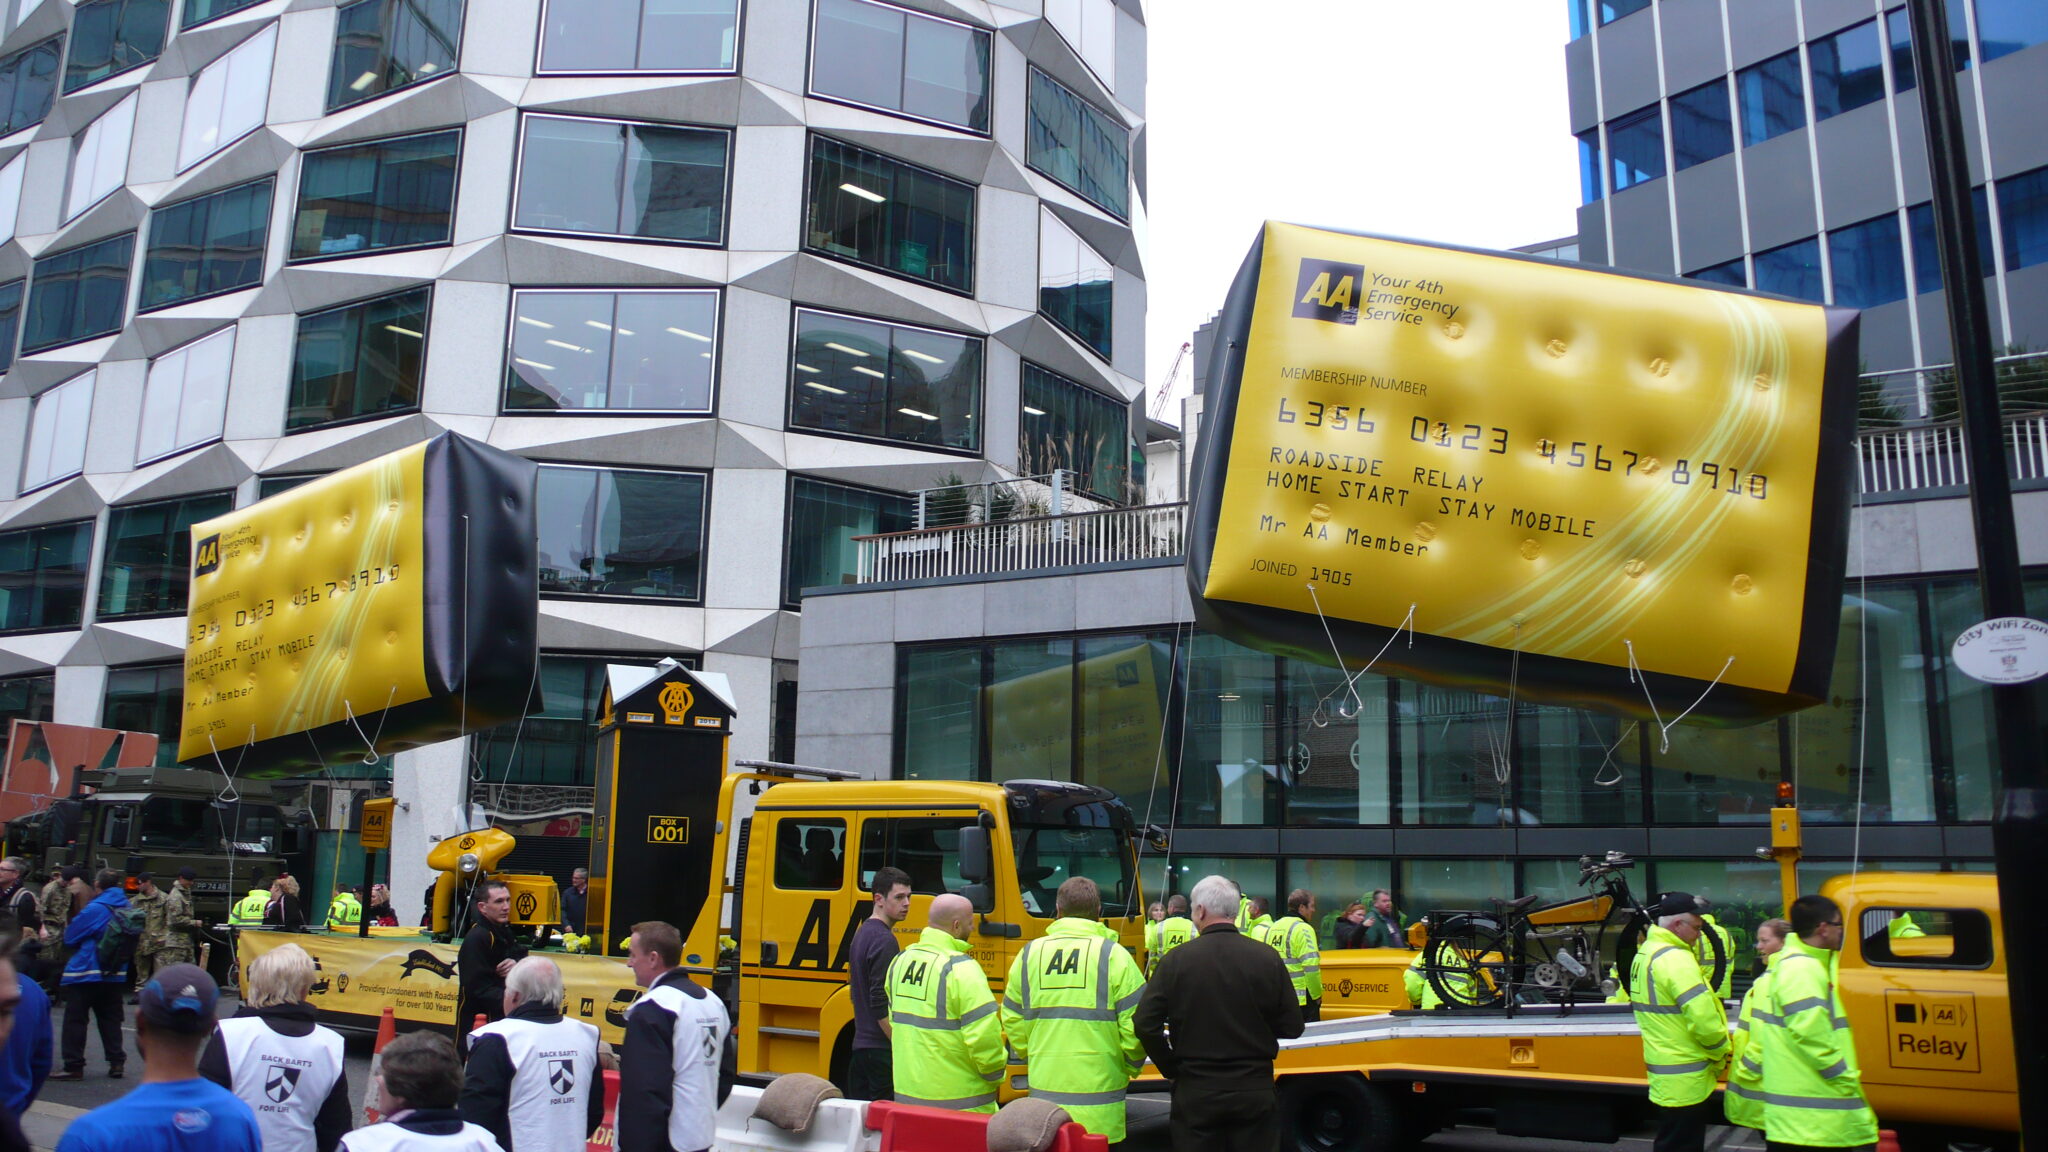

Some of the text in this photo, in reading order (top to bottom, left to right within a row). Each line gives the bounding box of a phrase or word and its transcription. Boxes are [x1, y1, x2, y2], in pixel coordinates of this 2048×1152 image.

[1300, 271, 1354, 309] AA
[1372, 272, 1444, 296] Your 4th
[1363, 307, 1423, 325] Service
[1366, 290, 1460, 319] Emergency
[1281, 367, 1428, 397] MEMBERSHIP NUMBER
[1278, 398, 1767, 500] 6356 0123 4567 8910
[1270, 447, 1483, 493] ROADSIDE RELAY
[1267, 471, 1596, 538] HOME START STAY MOBILE
[1260, 514, 1429, 557] Mr AA Member
[197, 541, 217, 569] AA
[1250, 558, 1352, 586] JOINED 1905
[236, 634, 264, 653] RELAY
[1957, 627, 1983, 647] City
[2021, 620, 2048, 637] Zon
[210, 658, 238, 676] START
[250, 647, 272, 665] STAY
[278, 634, 316, 657] MOBILE
[216, 686, 254, 702] Member
[366, 815, 383, 827] AA
[660, 818, 677, 827] BOX
[653, 826, 684, 842] 001
[248, 904, 260, 913] AA
[1169, 934, 1184, 946] AA
[901, 960, 927, 987] AA
[1045, 948, 1080, 976] AA
[359, 983, 386, 995] Providing
[386, 986, 418, 997] Londoners
[1354, 983, 1390, 993] SERVICE
[396, 998, 453, 1013] for over 100 Years
[1936, 1006, 1954, 1021] AA
[261, 1054, 285, 1063] BACK
[539, 1050, 558, 1058] BACK
[1898, 1033, 1968, 1061] Relay
